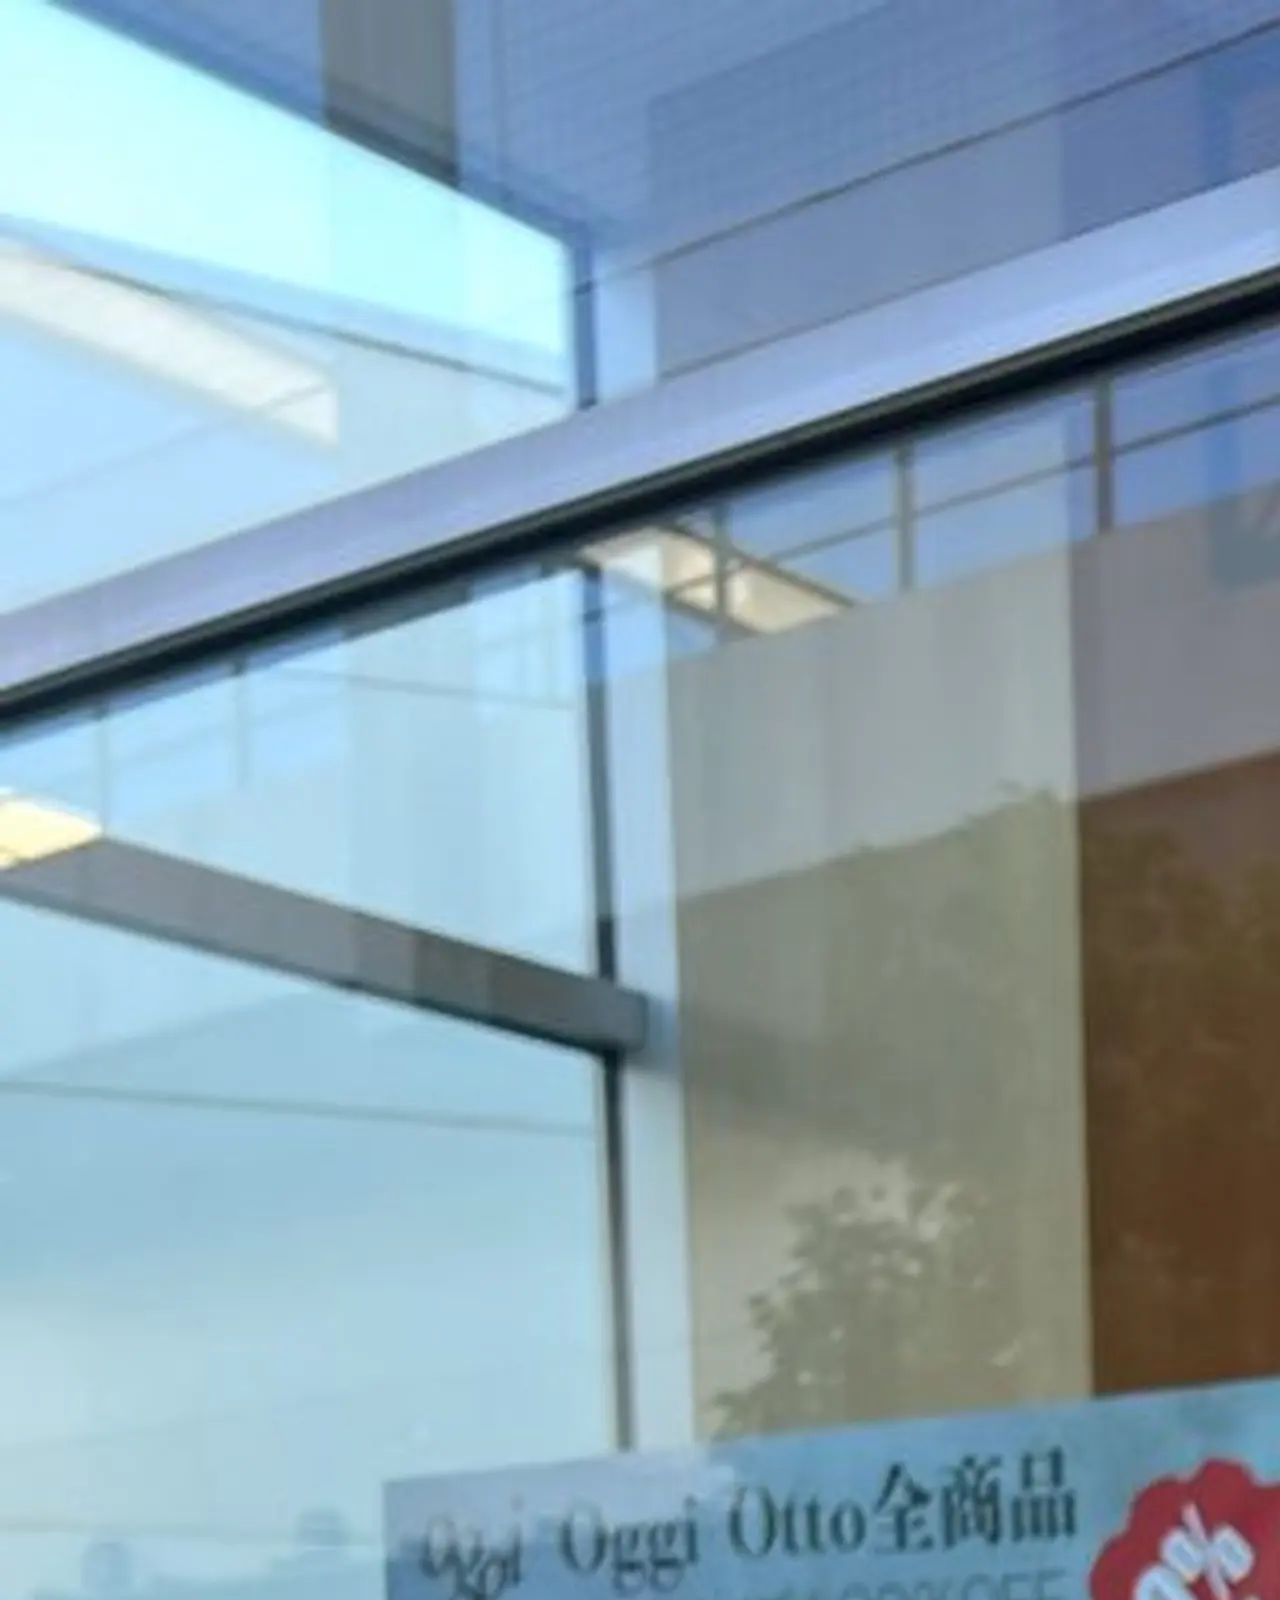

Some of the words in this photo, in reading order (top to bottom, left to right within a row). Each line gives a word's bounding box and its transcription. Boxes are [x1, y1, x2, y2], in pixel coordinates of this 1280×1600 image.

[559, 1495, 699, 1597] Oggi
[727, 1444, 1079, 1558] Otto全商品
